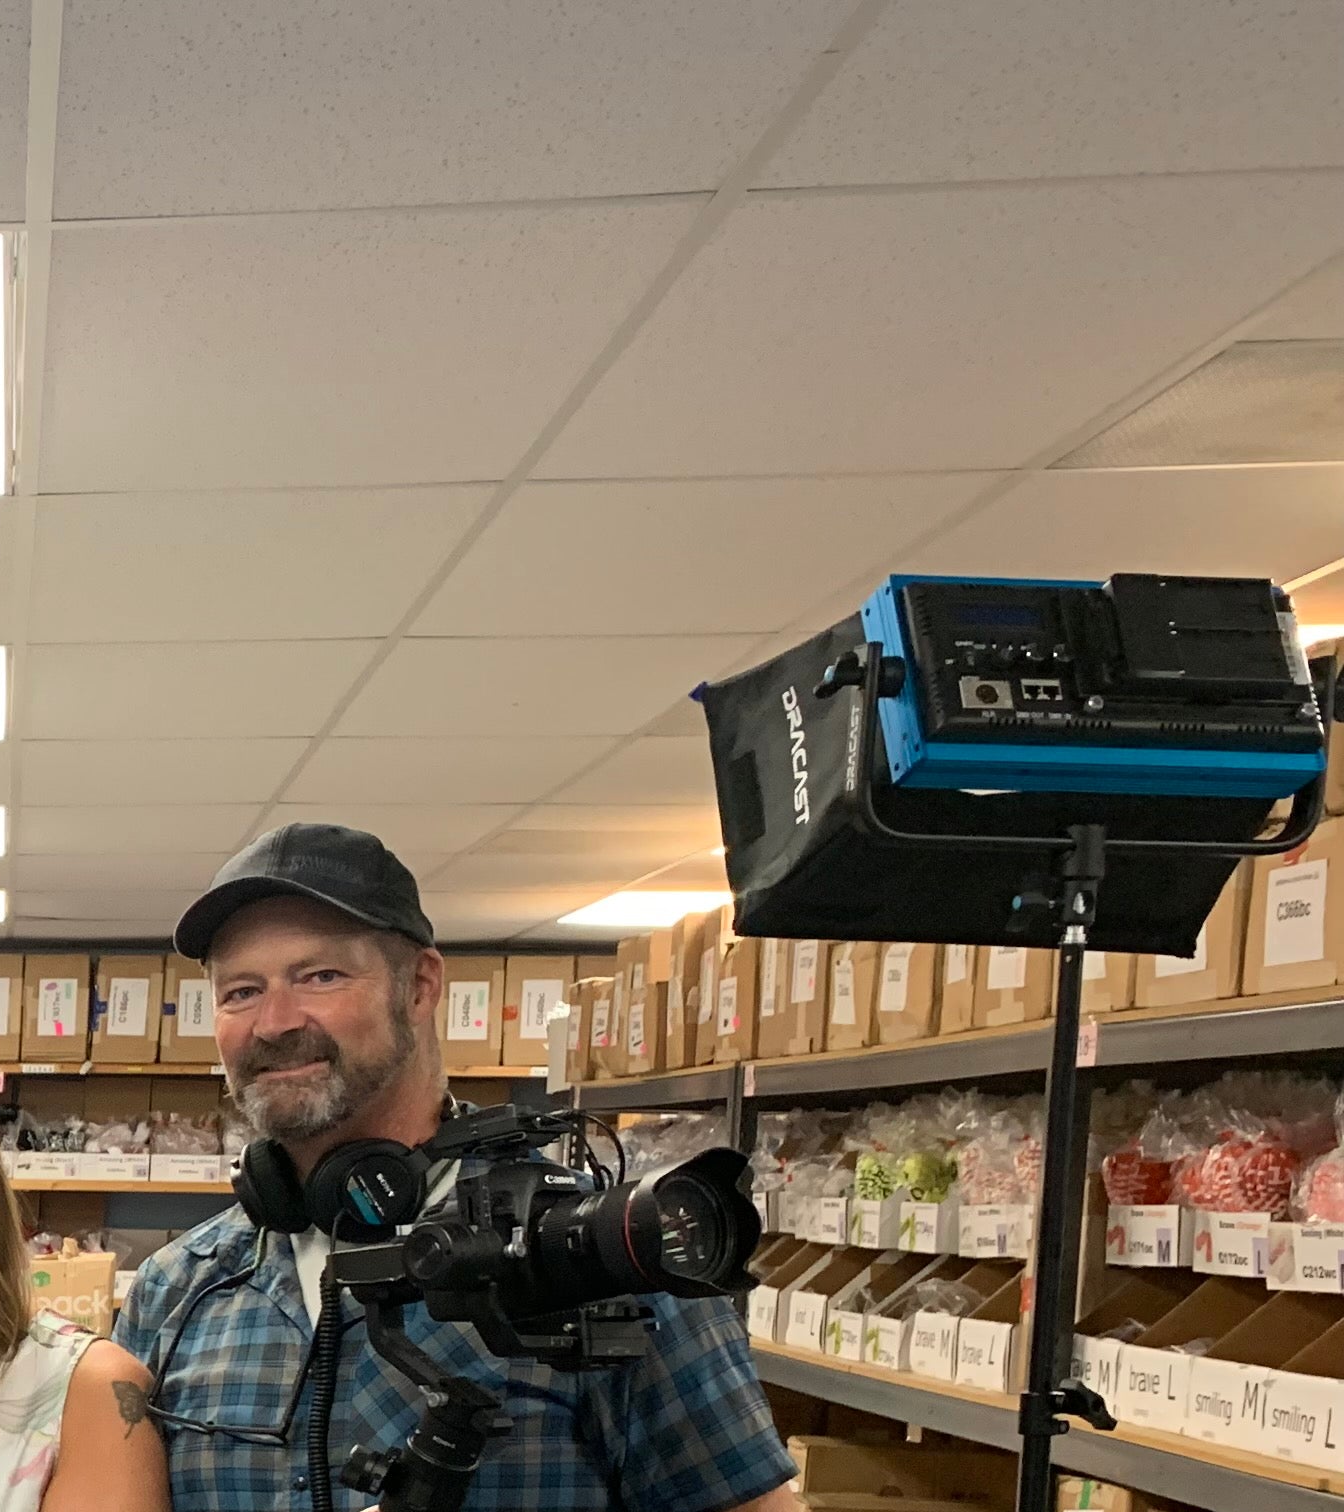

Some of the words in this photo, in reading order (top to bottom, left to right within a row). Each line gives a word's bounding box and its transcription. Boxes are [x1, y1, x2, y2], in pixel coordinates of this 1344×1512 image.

[782, 686, 810, 825] DRACAST
[544, 1173, 576, 1185] Canon
[1158, 1240, 1171, 1264] M
[1129, 1364, 1160, 1394] brave
[1167, 1364, 1176, 1401] L
[1195, 1392, 1233, 1426] smiling
[1242, 1381, 1259, 1421] M
[1271, 1405, 1316, 1441] smiling
[1325, 1407, 1336, 1449] L
